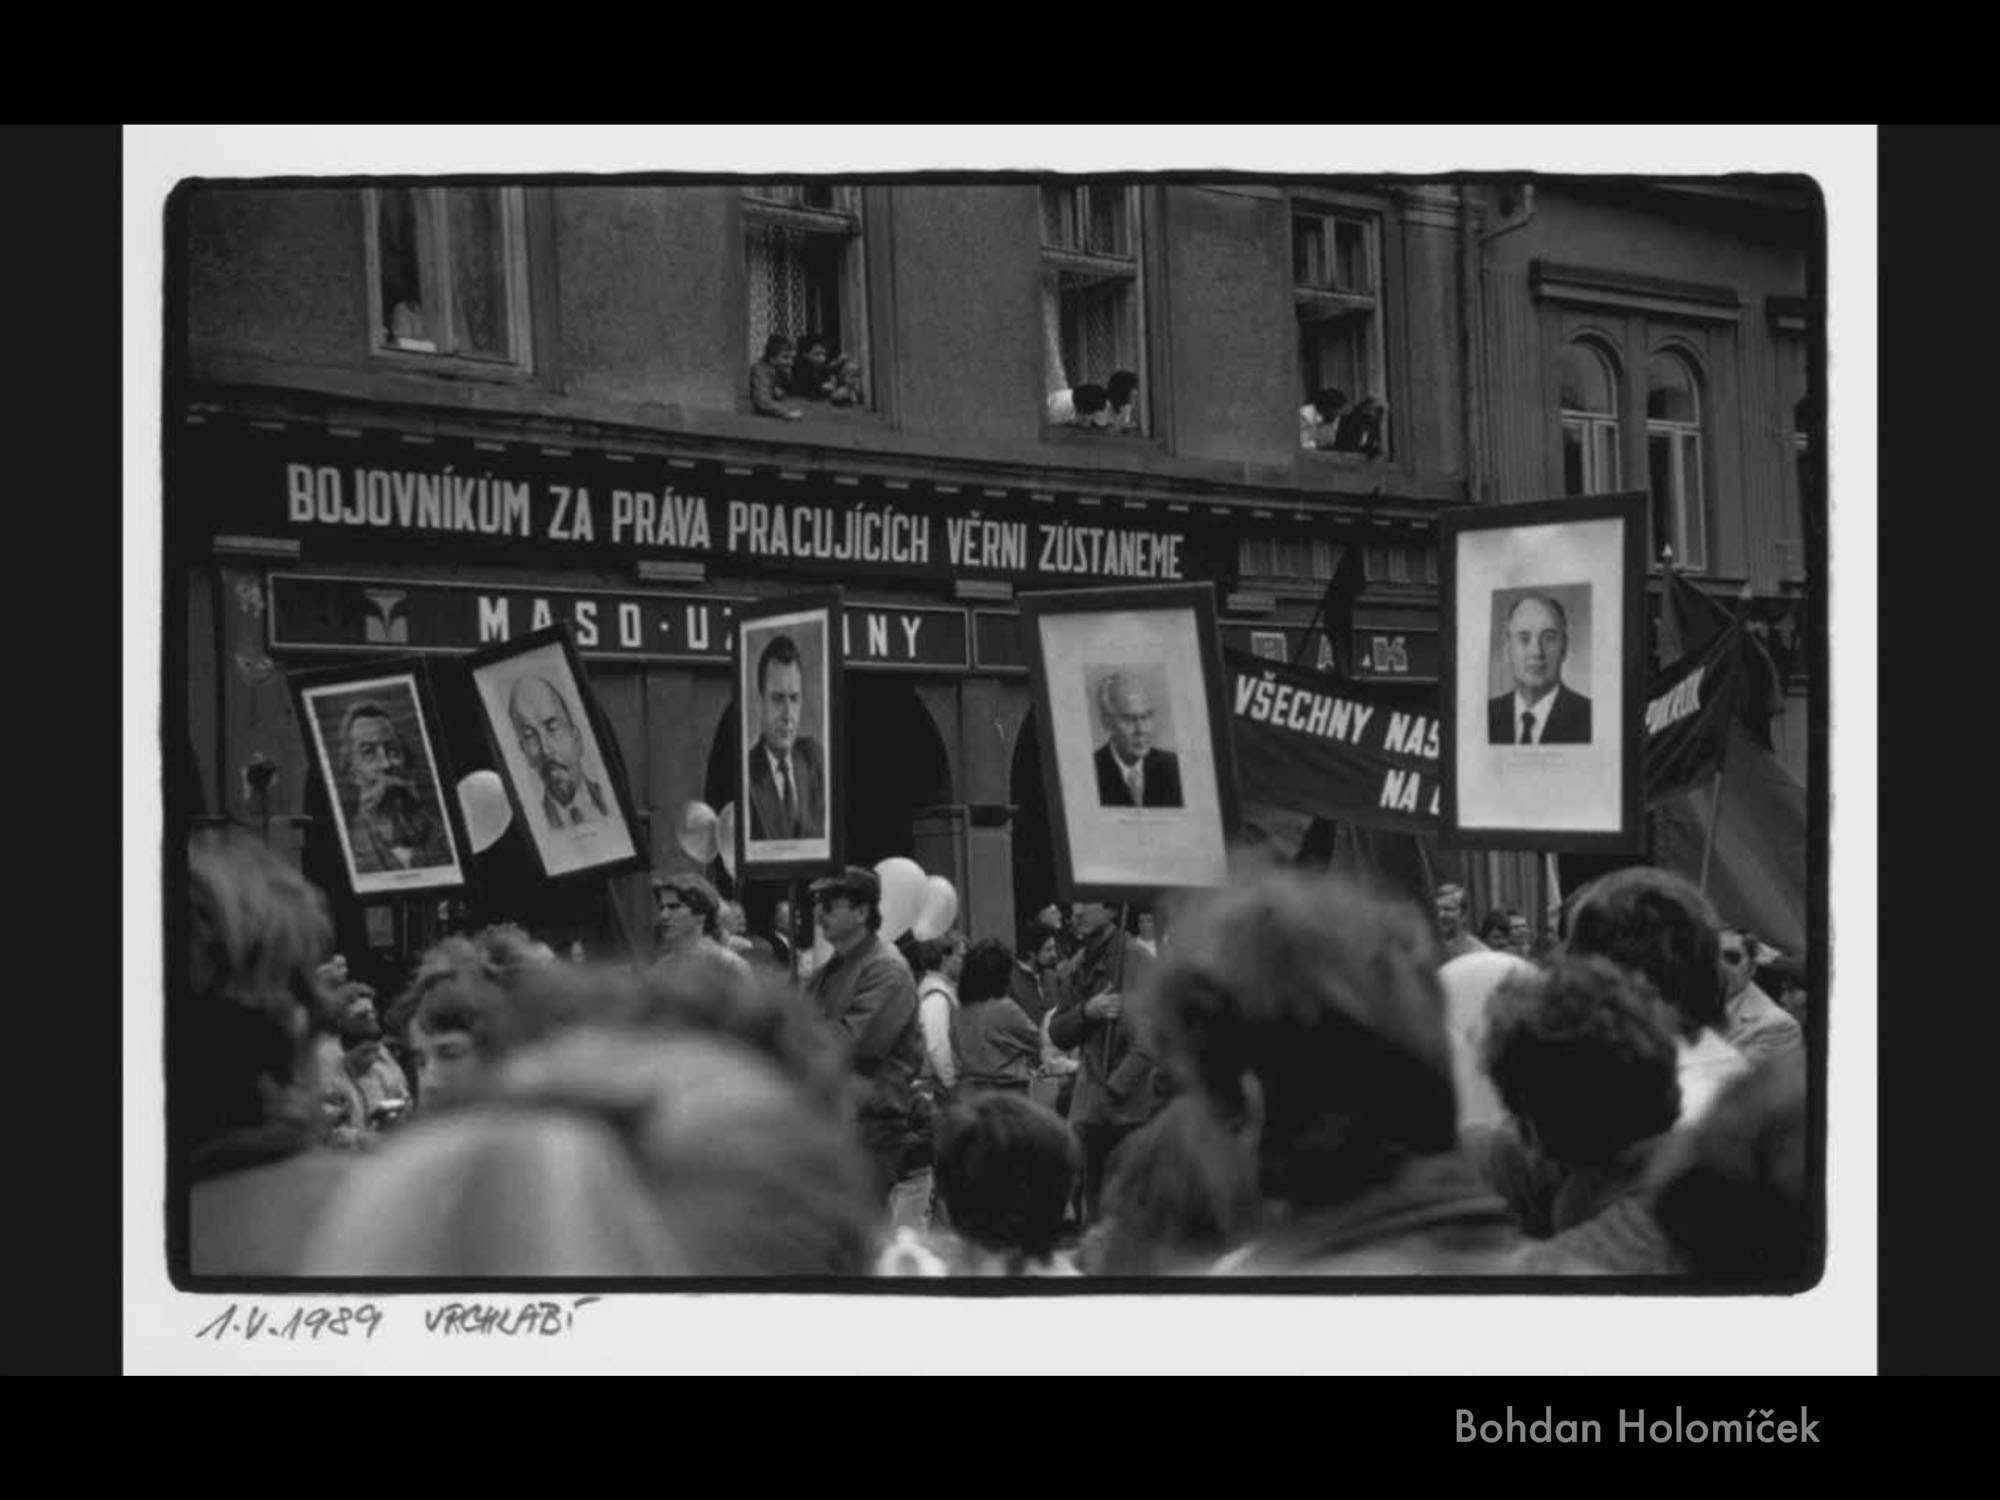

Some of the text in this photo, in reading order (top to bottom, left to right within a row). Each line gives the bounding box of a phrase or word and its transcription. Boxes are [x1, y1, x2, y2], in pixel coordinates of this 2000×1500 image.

[549, 485, 595, 541] ZA
[613, 486, 711, 549] PRÁVA
[728, 500, 929, 564] PRACUJÍCÍCH
[947, 509, 1028, 570] VĚRNI
[1234, 670, 1375, 744] VŠECHNY
[1379, 768, 1422, 813] NA
